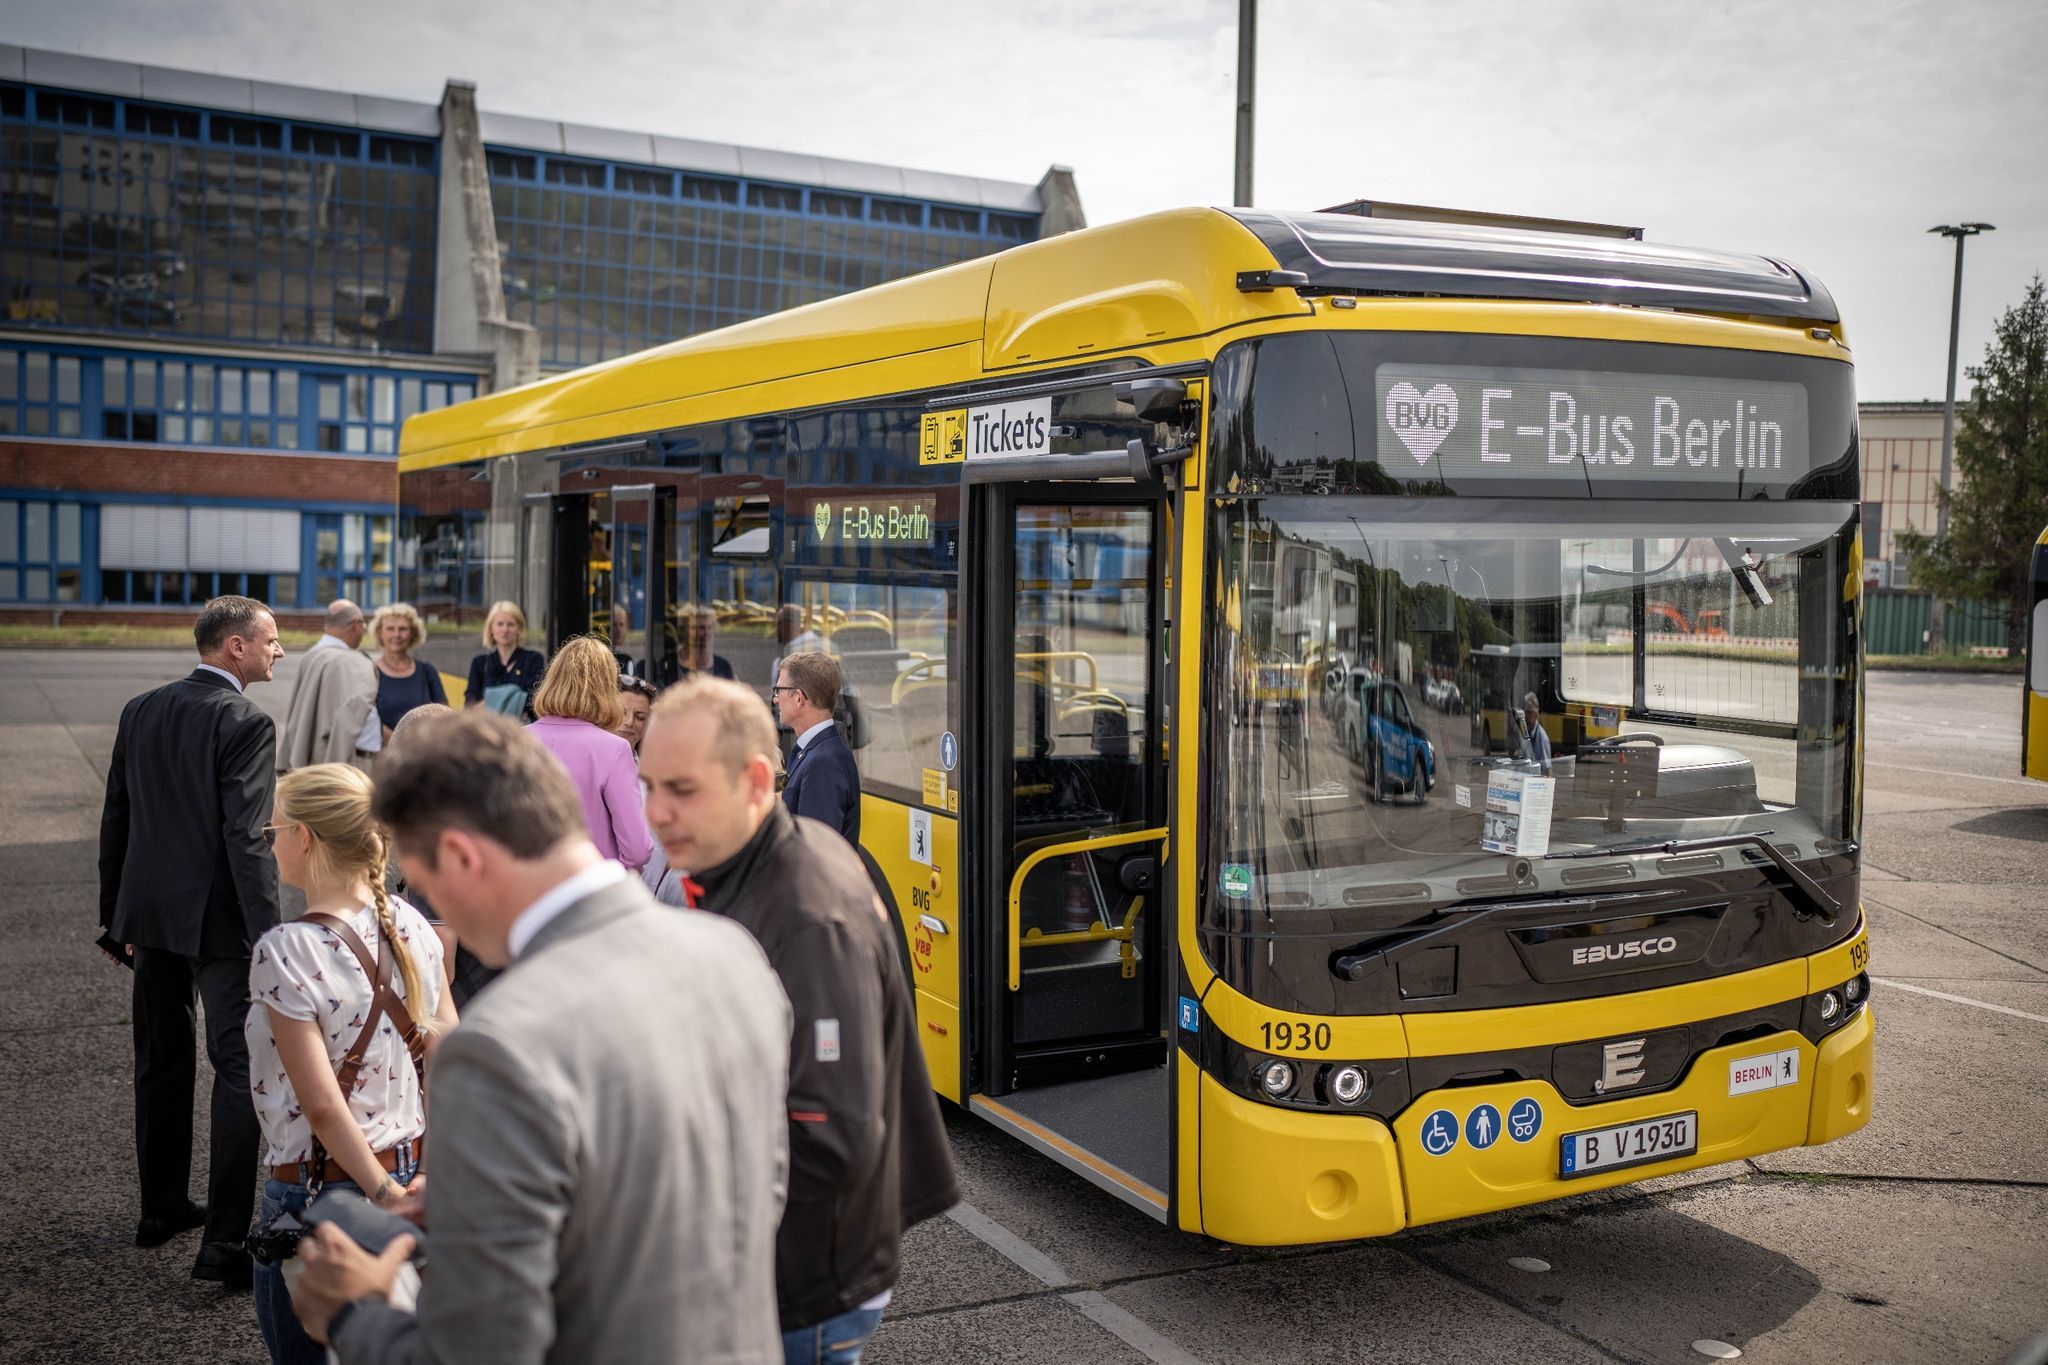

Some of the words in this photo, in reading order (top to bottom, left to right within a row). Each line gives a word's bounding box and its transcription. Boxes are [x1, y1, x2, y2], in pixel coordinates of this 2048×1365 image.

[1395, 401, 1450, 430] BVG
[1481, 388, 1635, 465] E-Bus
[1653, 396, 1783, 469] Berlin
[973, 408, 1045, 454] Tickets
[843, 506, 885, 539] E-Bus
[888, 505, 929, 539] Berlin
[1232, 868, 1241, 882] 4
[912, 886, 930, 911] BVG
[915, 936, 932, 957] VBB
[1572, 936, 1677, 965] EBUSCO
[1260, 1021, 1332, 1051] 1930
[1735, 1065, 1772, 1084] BERLIN
[1585, 1136, 1600, 1165] B
